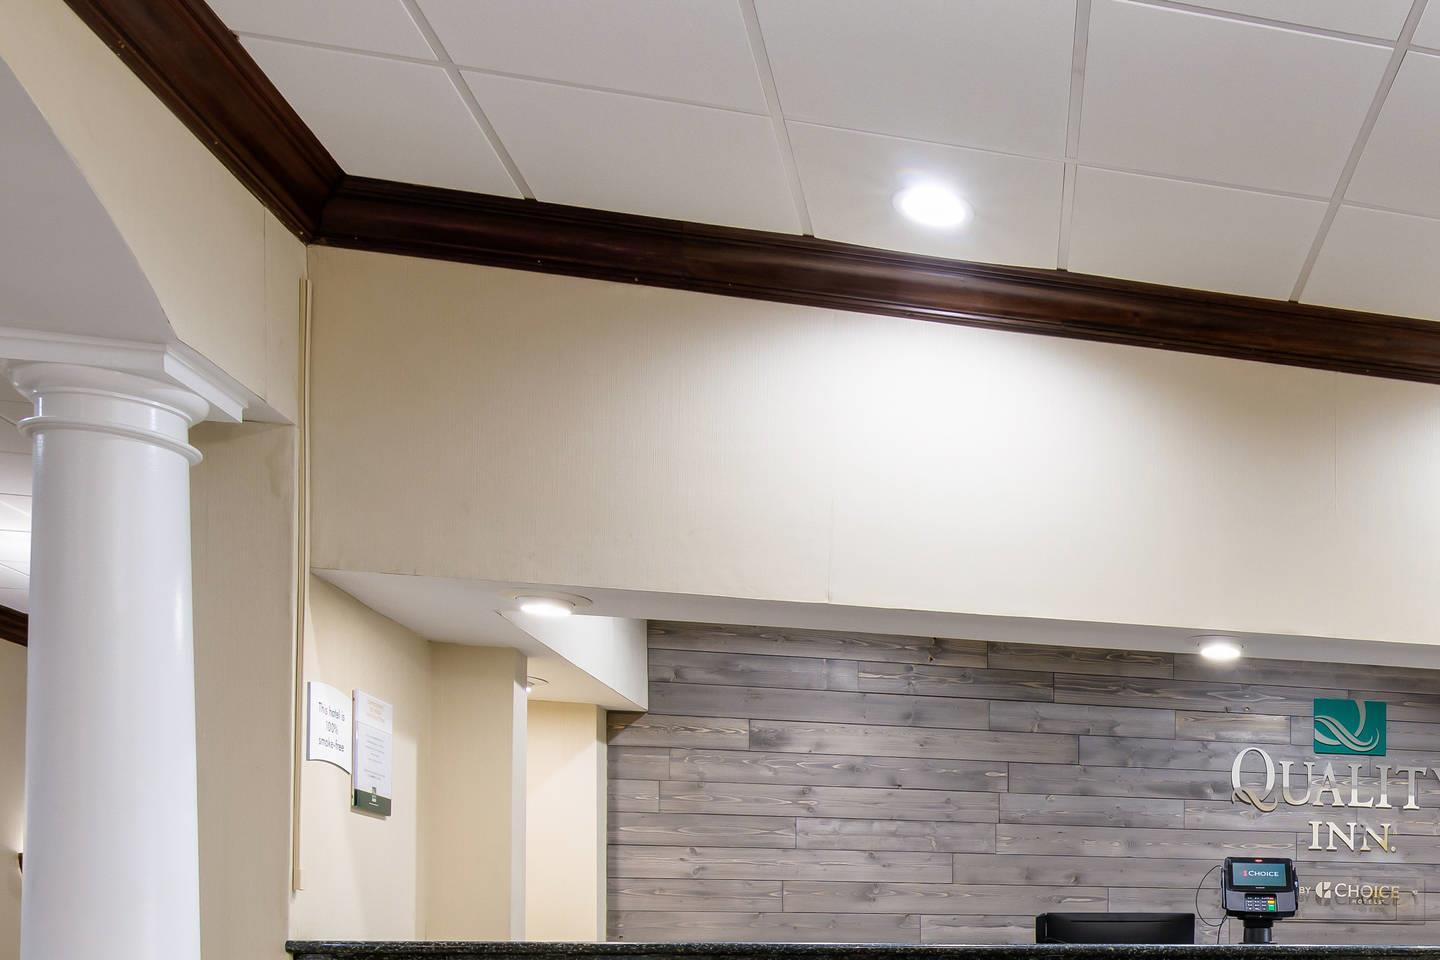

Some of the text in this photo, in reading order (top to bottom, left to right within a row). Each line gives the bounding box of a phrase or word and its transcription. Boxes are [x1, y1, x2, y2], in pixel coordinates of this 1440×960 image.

[318, 701, 328, 716] This
[329, 705, 341, 720] hotel
[326, 720, 339, 735] 100%
[318, 737, 345, 753] smoke-free
[1308, 821, 1392, 852] INN
[1299, 883, 1400, 899] BY CHOICE
